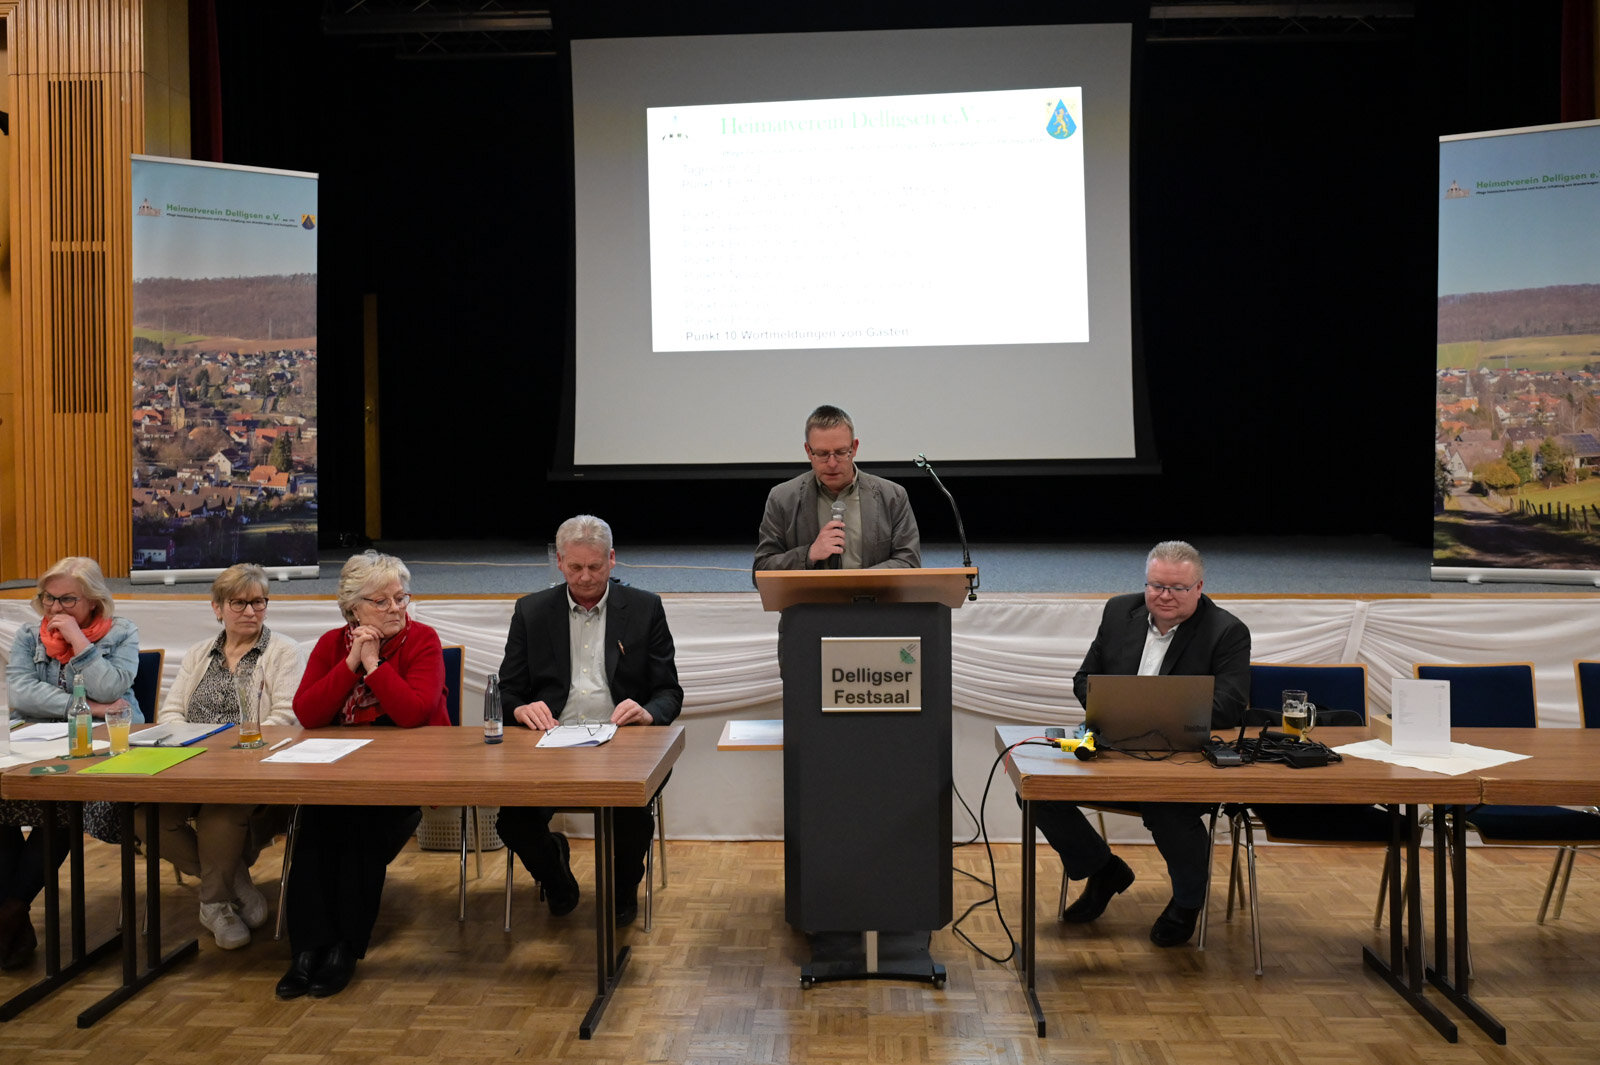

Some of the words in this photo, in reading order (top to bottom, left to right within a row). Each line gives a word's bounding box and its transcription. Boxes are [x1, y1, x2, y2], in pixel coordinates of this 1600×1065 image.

[1476, 176, 1539, 189] Heimatverein
[1542, 173, 1587, 184] Delligsen
[166, 203, 223, 216] Heimatverein
[225, 208, 263, 220] Delligsen
[686, 330, 721, 342] Punkt
[725, 330, 738, 341] 10
[741, 328, 836, 341] Wortmeldungen
[840, 330, 863, 338] von
[831, 667, 913, 686] Delligser
[834, 689, 909, 704] Festsaal
